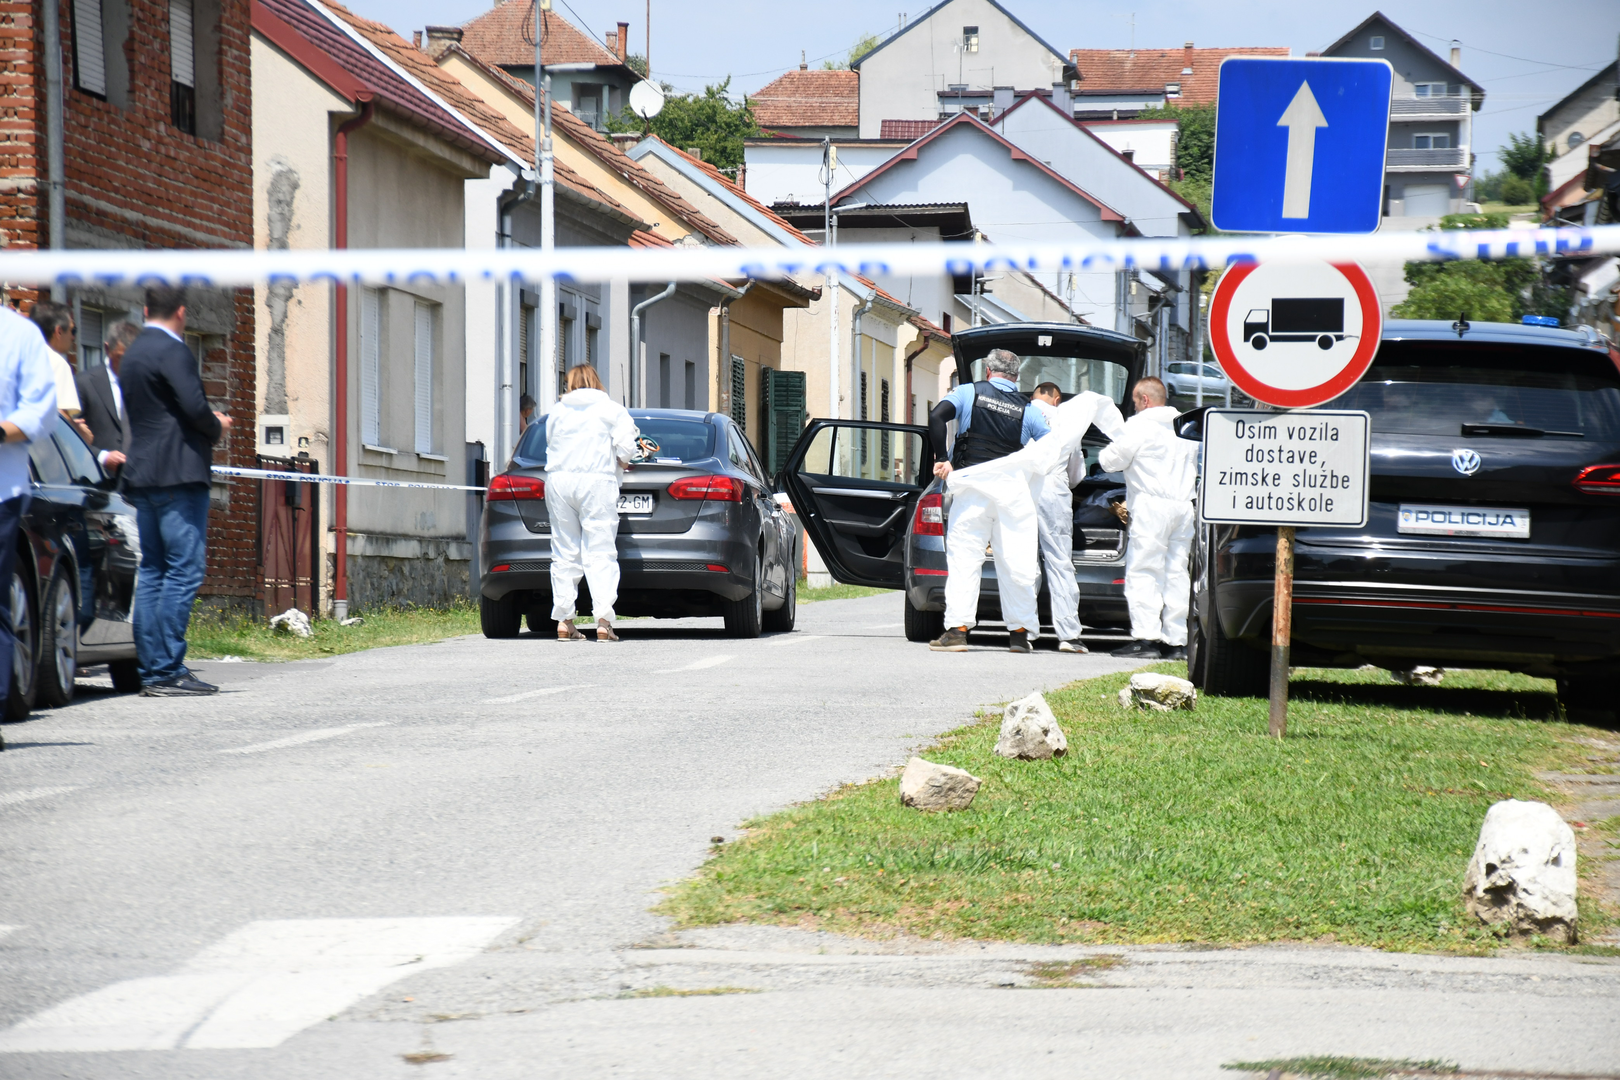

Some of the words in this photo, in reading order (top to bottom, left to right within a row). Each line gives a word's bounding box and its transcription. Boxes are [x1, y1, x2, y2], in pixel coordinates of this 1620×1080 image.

[987, 403, 1010, 414] POLICIJA
[1235, 419, 1277, 440] Osim
[1287, 422, 1339, 442] vozila
[1245, 444, 1326, 468] dostave,
[1218, 467, 1281, 487] zimske
[1292, 469, 1350, 489] službe
[1232, 491, 1236, 509] i
[1245, 492, 1334, 512] autoškole
[1415, 510, 1517, 527] POLICIJA
